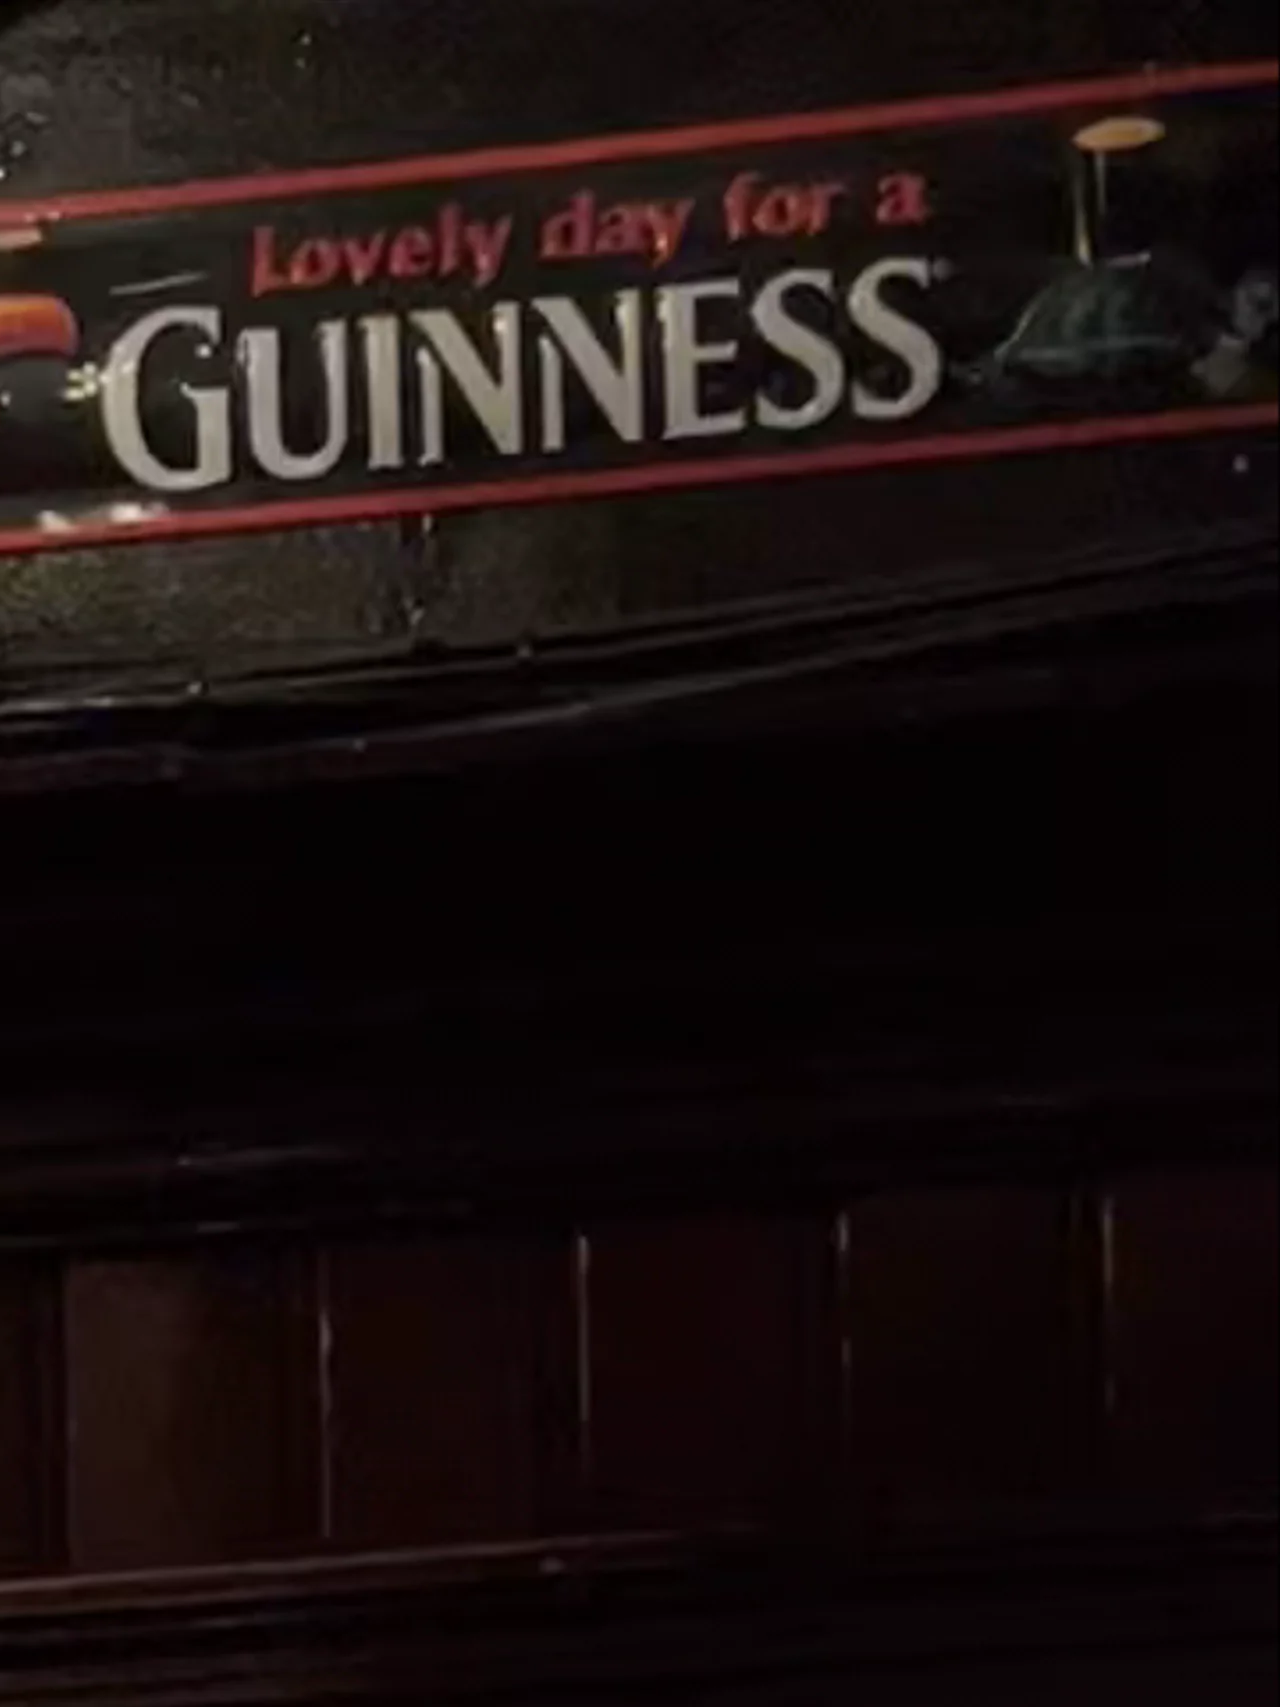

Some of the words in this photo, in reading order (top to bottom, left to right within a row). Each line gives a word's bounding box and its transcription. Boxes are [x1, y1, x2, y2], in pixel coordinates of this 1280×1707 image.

[252, 200, 511, 297] Lovely
[542, 188, 690, 268] day
[725, 170, 842, 238] for
[877, 172, 928, 226] a
[100, 256, 946, 492] GUINNESS
